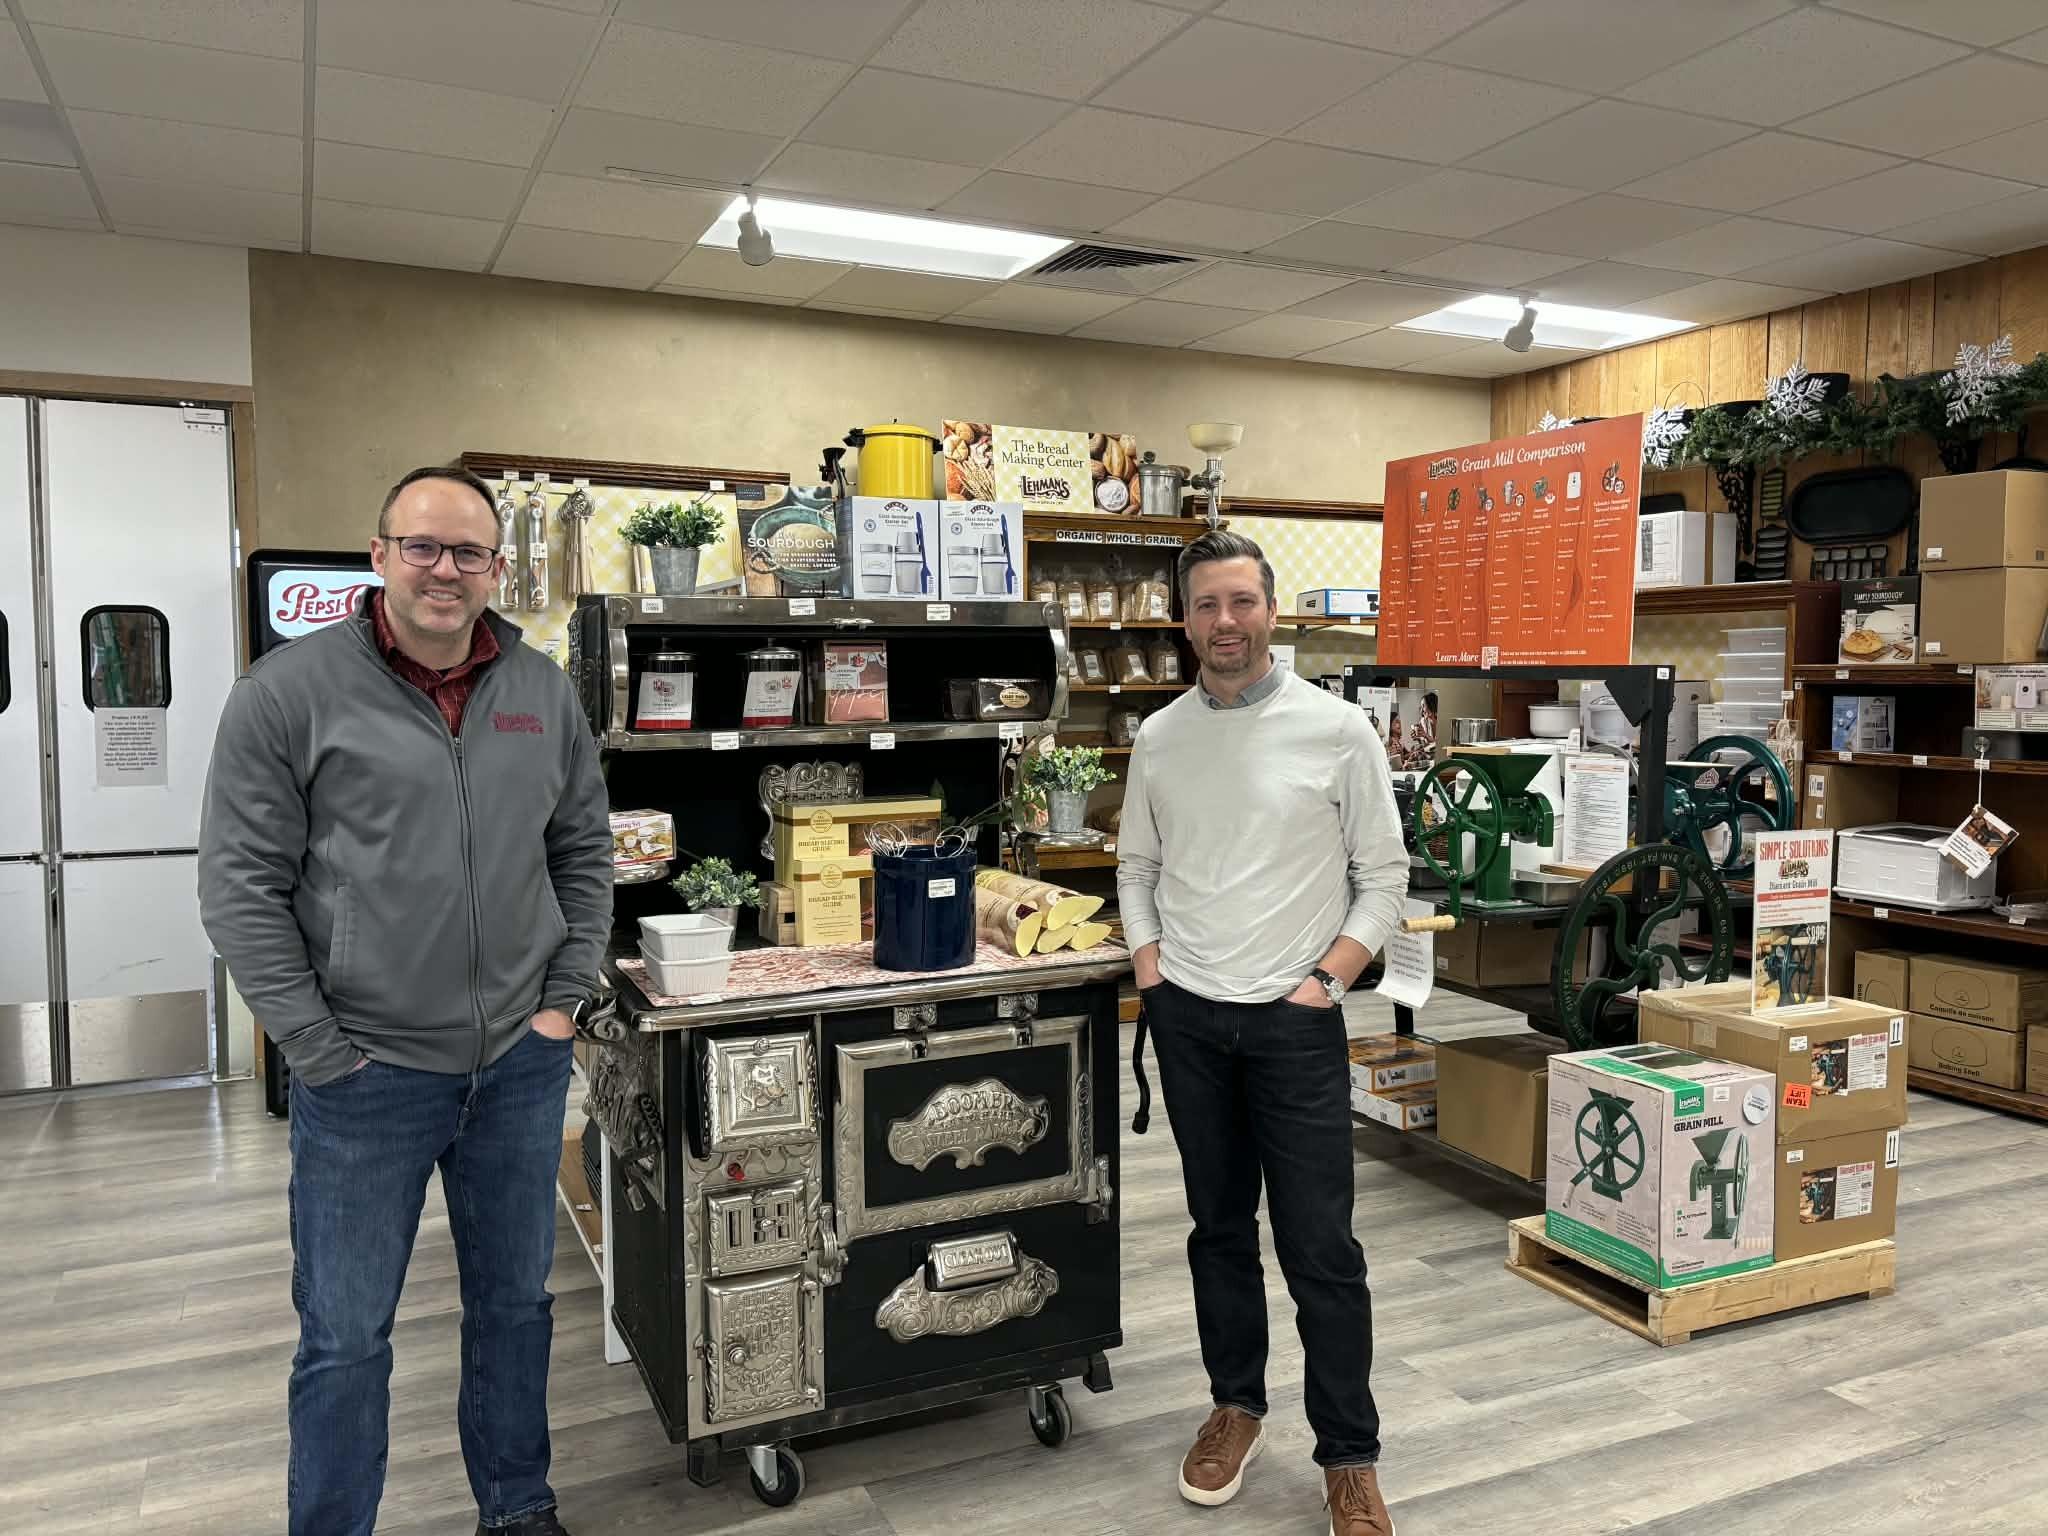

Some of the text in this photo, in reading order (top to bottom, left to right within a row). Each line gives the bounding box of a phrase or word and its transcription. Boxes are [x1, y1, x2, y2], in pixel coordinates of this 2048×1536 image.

[1011, 439, 1069, 455] The Bread
[1002, 451, 1085, 469] Making Center
[1461, 440, 1587, 474] Grain Mill Comparison
[747, 537, 835, 549] SOURDOUGH
[1056, 530, 1182, 546] ORGANIC WHOLE GRAINS
[1435, 651, 1479, 663] Learn More
[1759, 839, 1829, 860] SIMPLE SOLUTIONS
[1786, 1096, 1807, 1107] TEAM
[1789, 1089, 1806, 1098] LIFT
[1673, 1118, 1702, 1132] GRAIN
[1703, 1115, 1724, 1128] MILL
